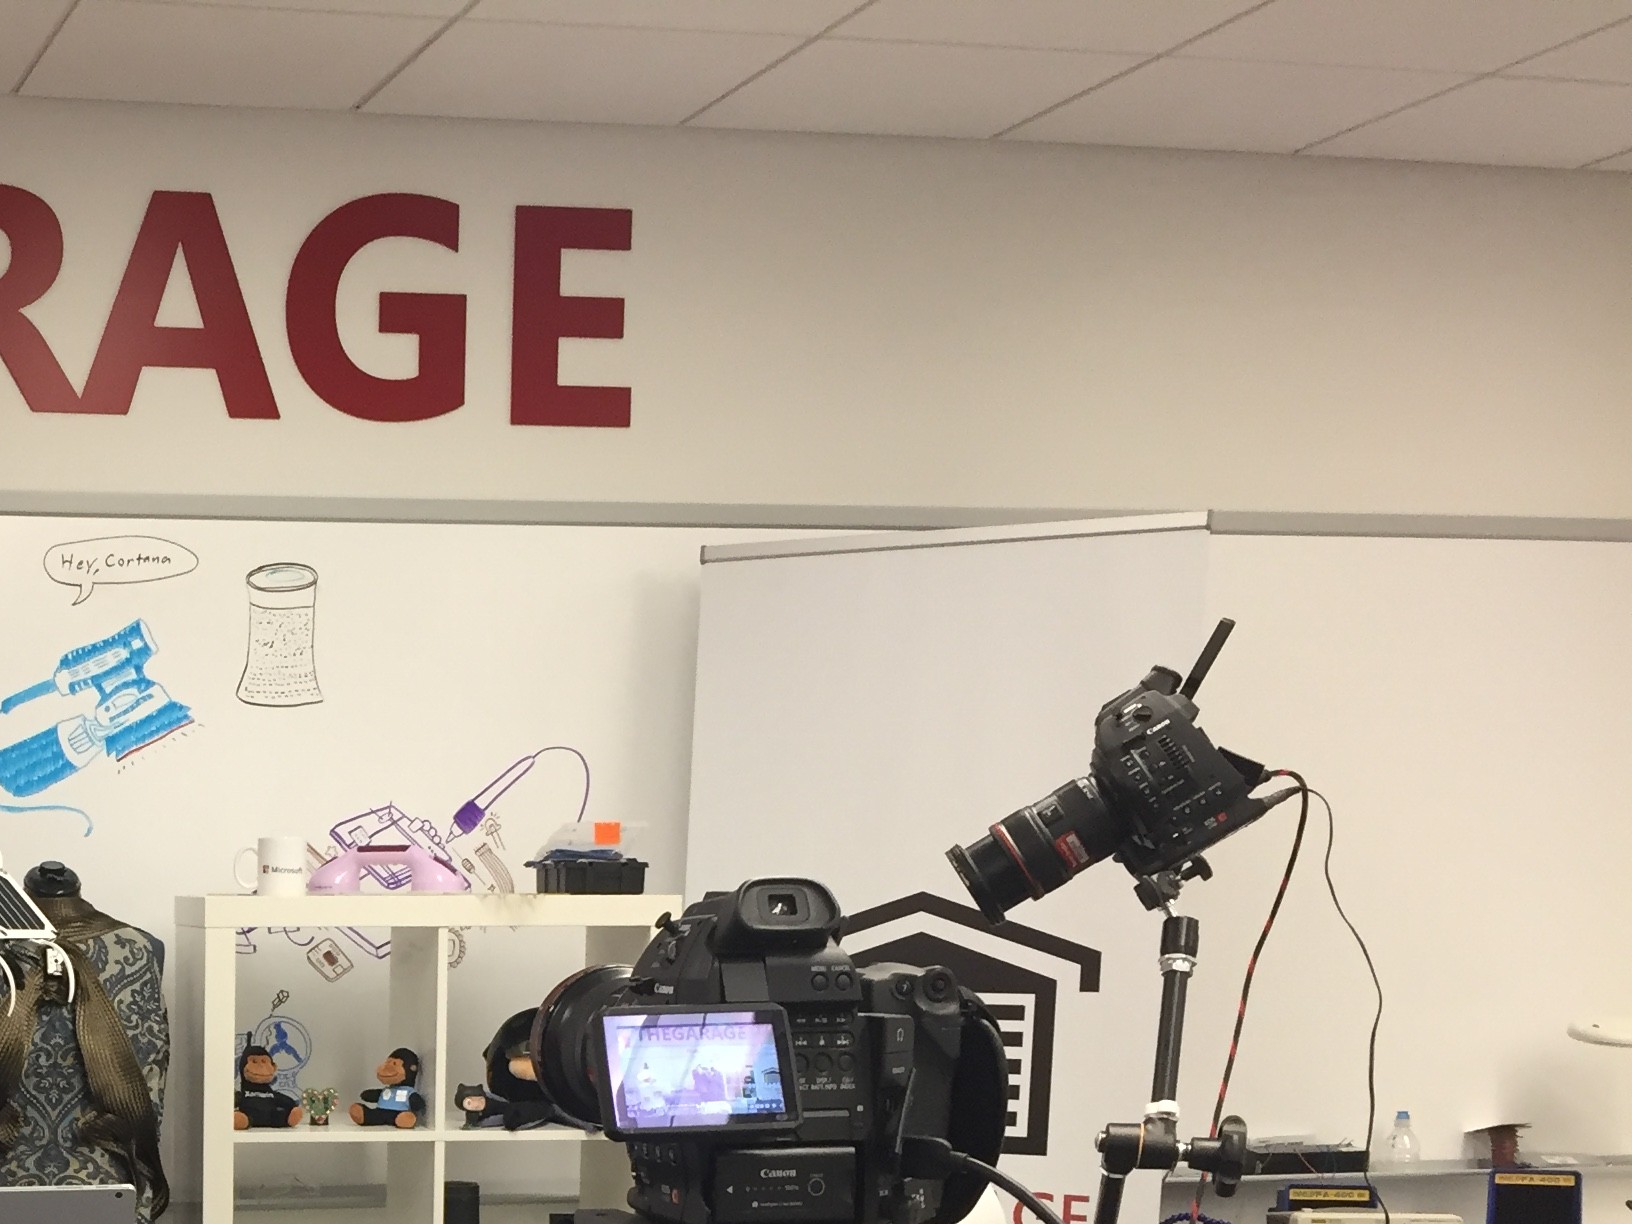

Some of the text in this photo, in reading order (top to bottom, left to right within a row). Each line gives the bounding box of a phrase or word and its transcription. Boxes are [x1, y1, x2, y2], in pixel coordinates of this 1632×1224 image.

[61, 553, 172, 575] Hey, Cortana
[271, 866, 303, 874] Microsoft
[760, 1168, 797, 1179] Canon
